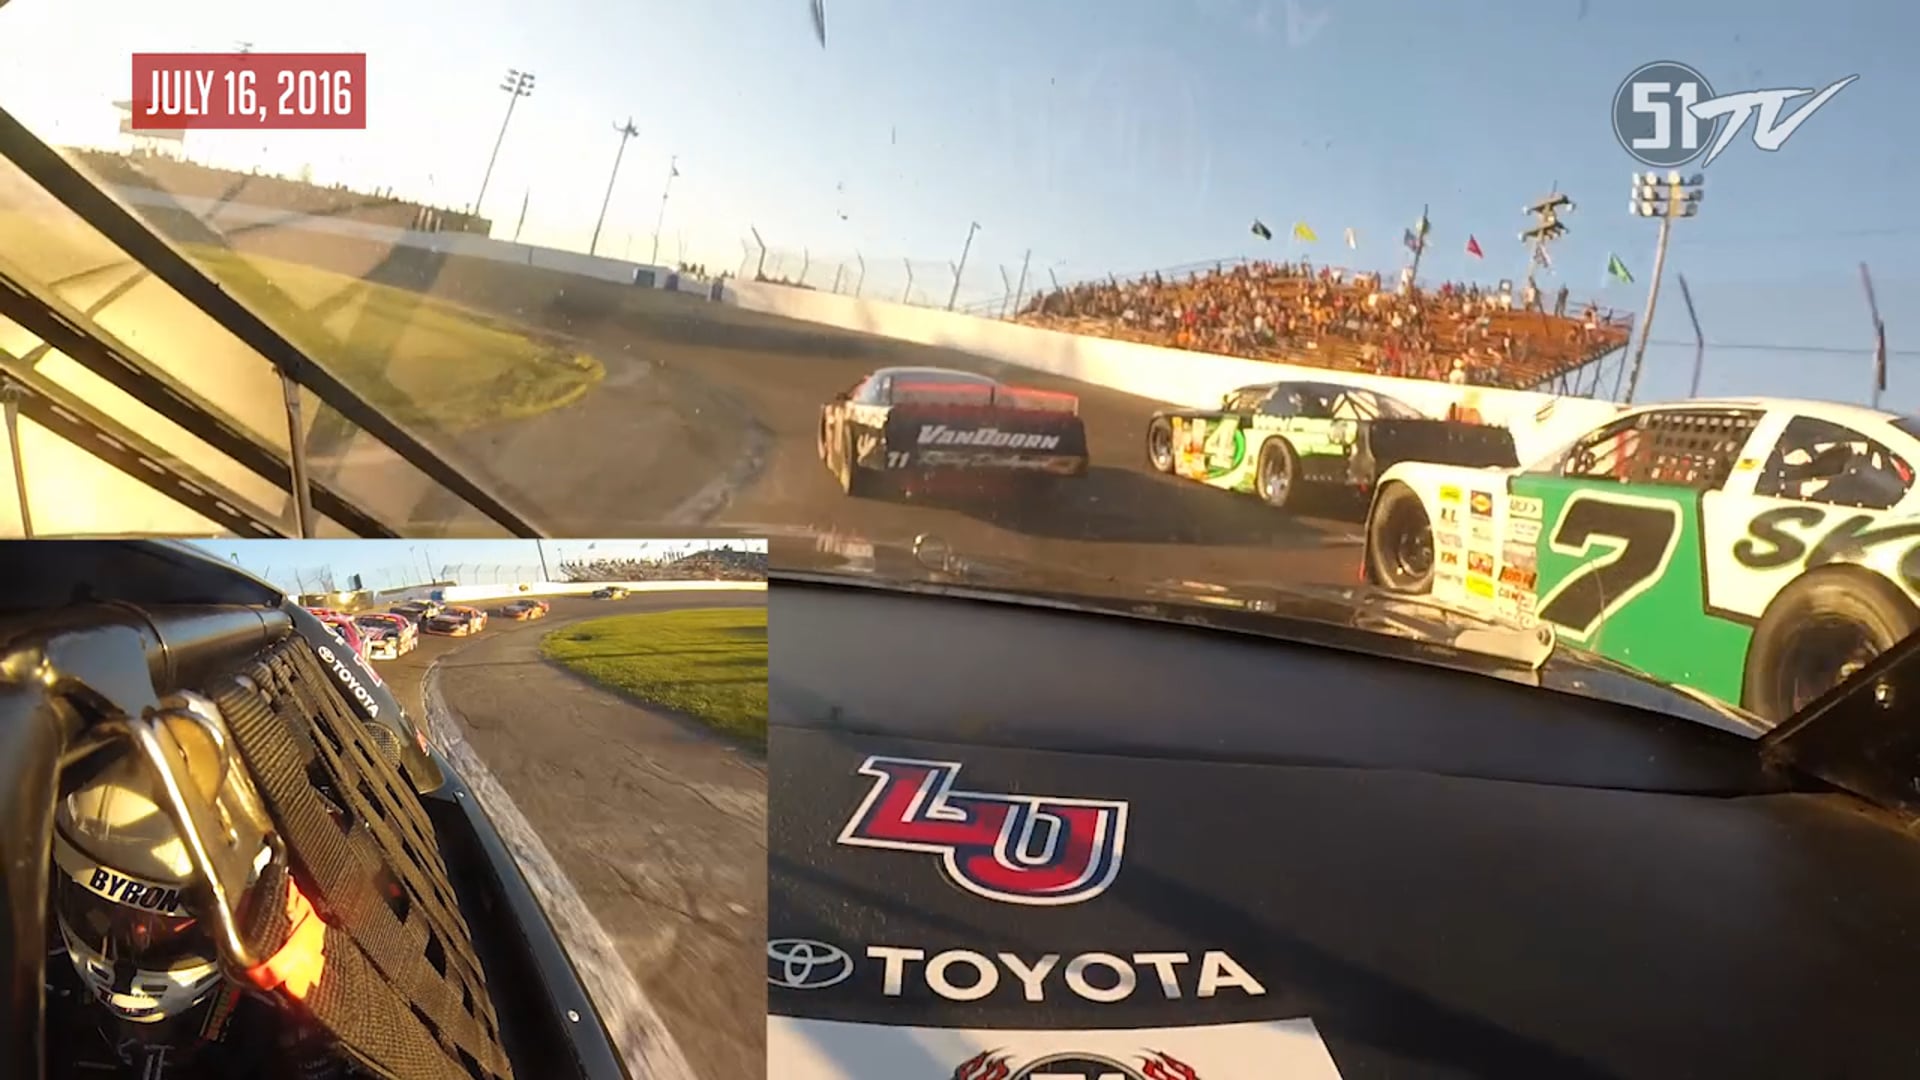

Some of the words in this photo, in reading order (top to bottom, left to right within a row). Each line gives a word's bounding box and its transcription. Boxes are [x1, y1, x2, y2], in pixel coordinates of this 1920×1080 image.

[1538, 495, 1678, 636] 7
[322, 659, 379, 718] TOYOTA
[837, 755, 1128, 905] LU
[89, 867, 181, 912] BYRON
[866, 945, 1266, 1001] TOYOTA
